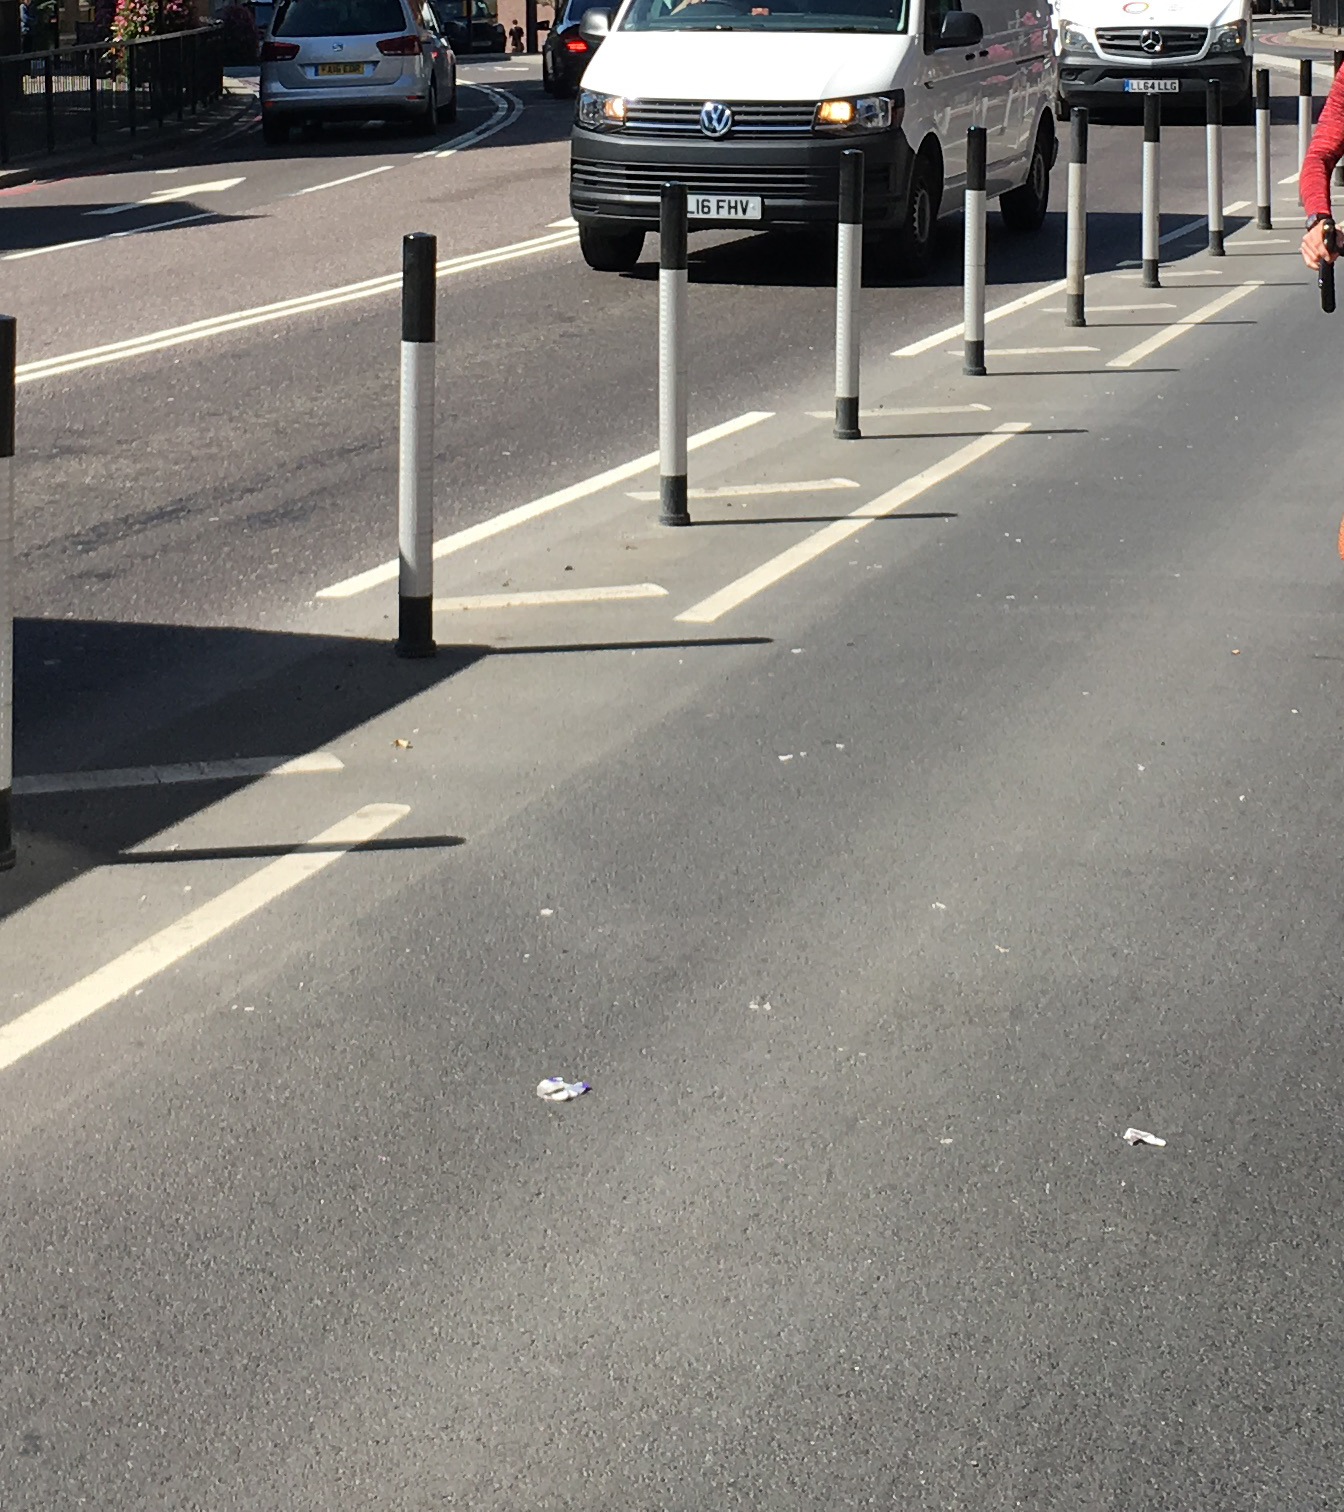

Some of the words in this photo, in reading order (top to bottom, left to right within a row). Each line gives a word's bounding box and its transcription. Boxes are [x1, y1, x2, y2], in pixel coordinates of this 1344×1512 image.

[1131, 81, 1156, 91] LL64
[1157, 81, 1177, 91] LLG
[716, 199, 749, 216] FHV
